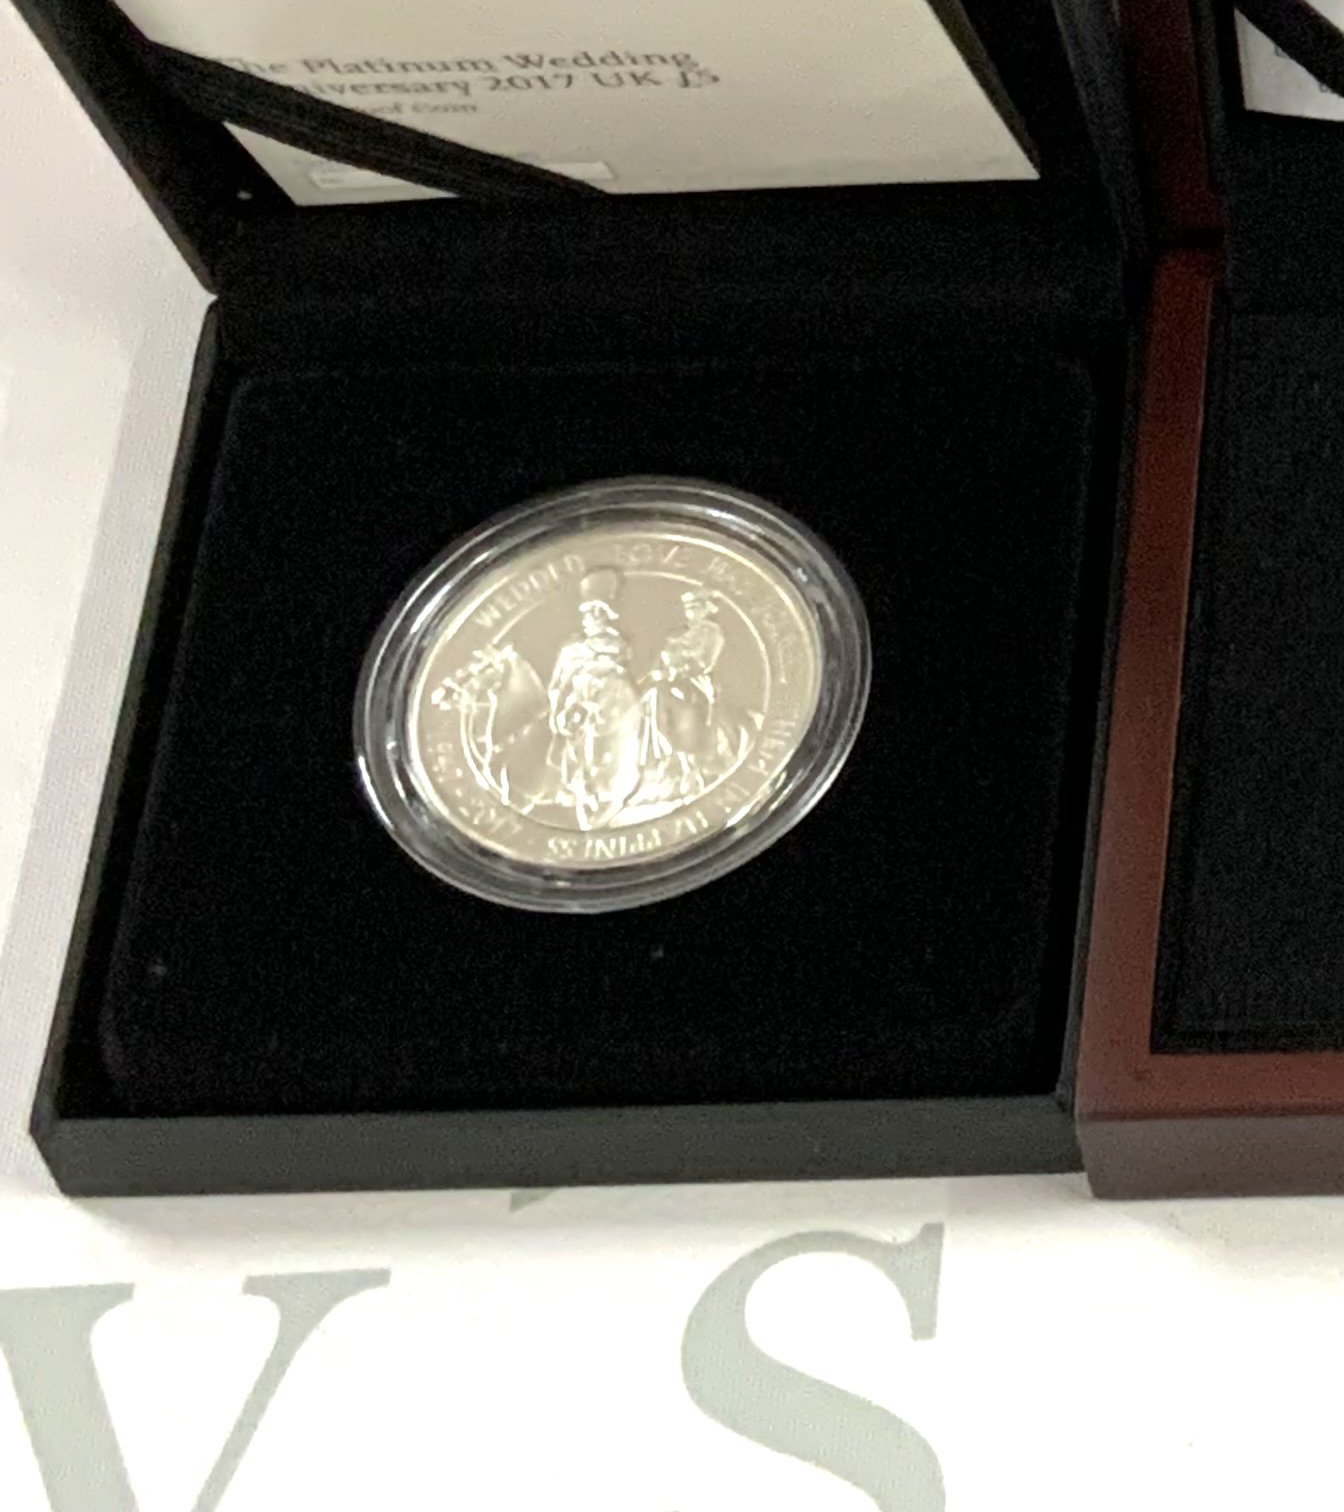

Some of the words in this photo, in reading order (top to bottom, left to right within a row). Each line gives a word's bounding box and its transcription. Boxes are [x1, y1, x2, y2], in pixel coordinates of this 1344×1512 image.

[302, 58, 497, 74] Platinum
[502, 51, 699, 71] Wedding
[592, 71, 662, 86] UK
